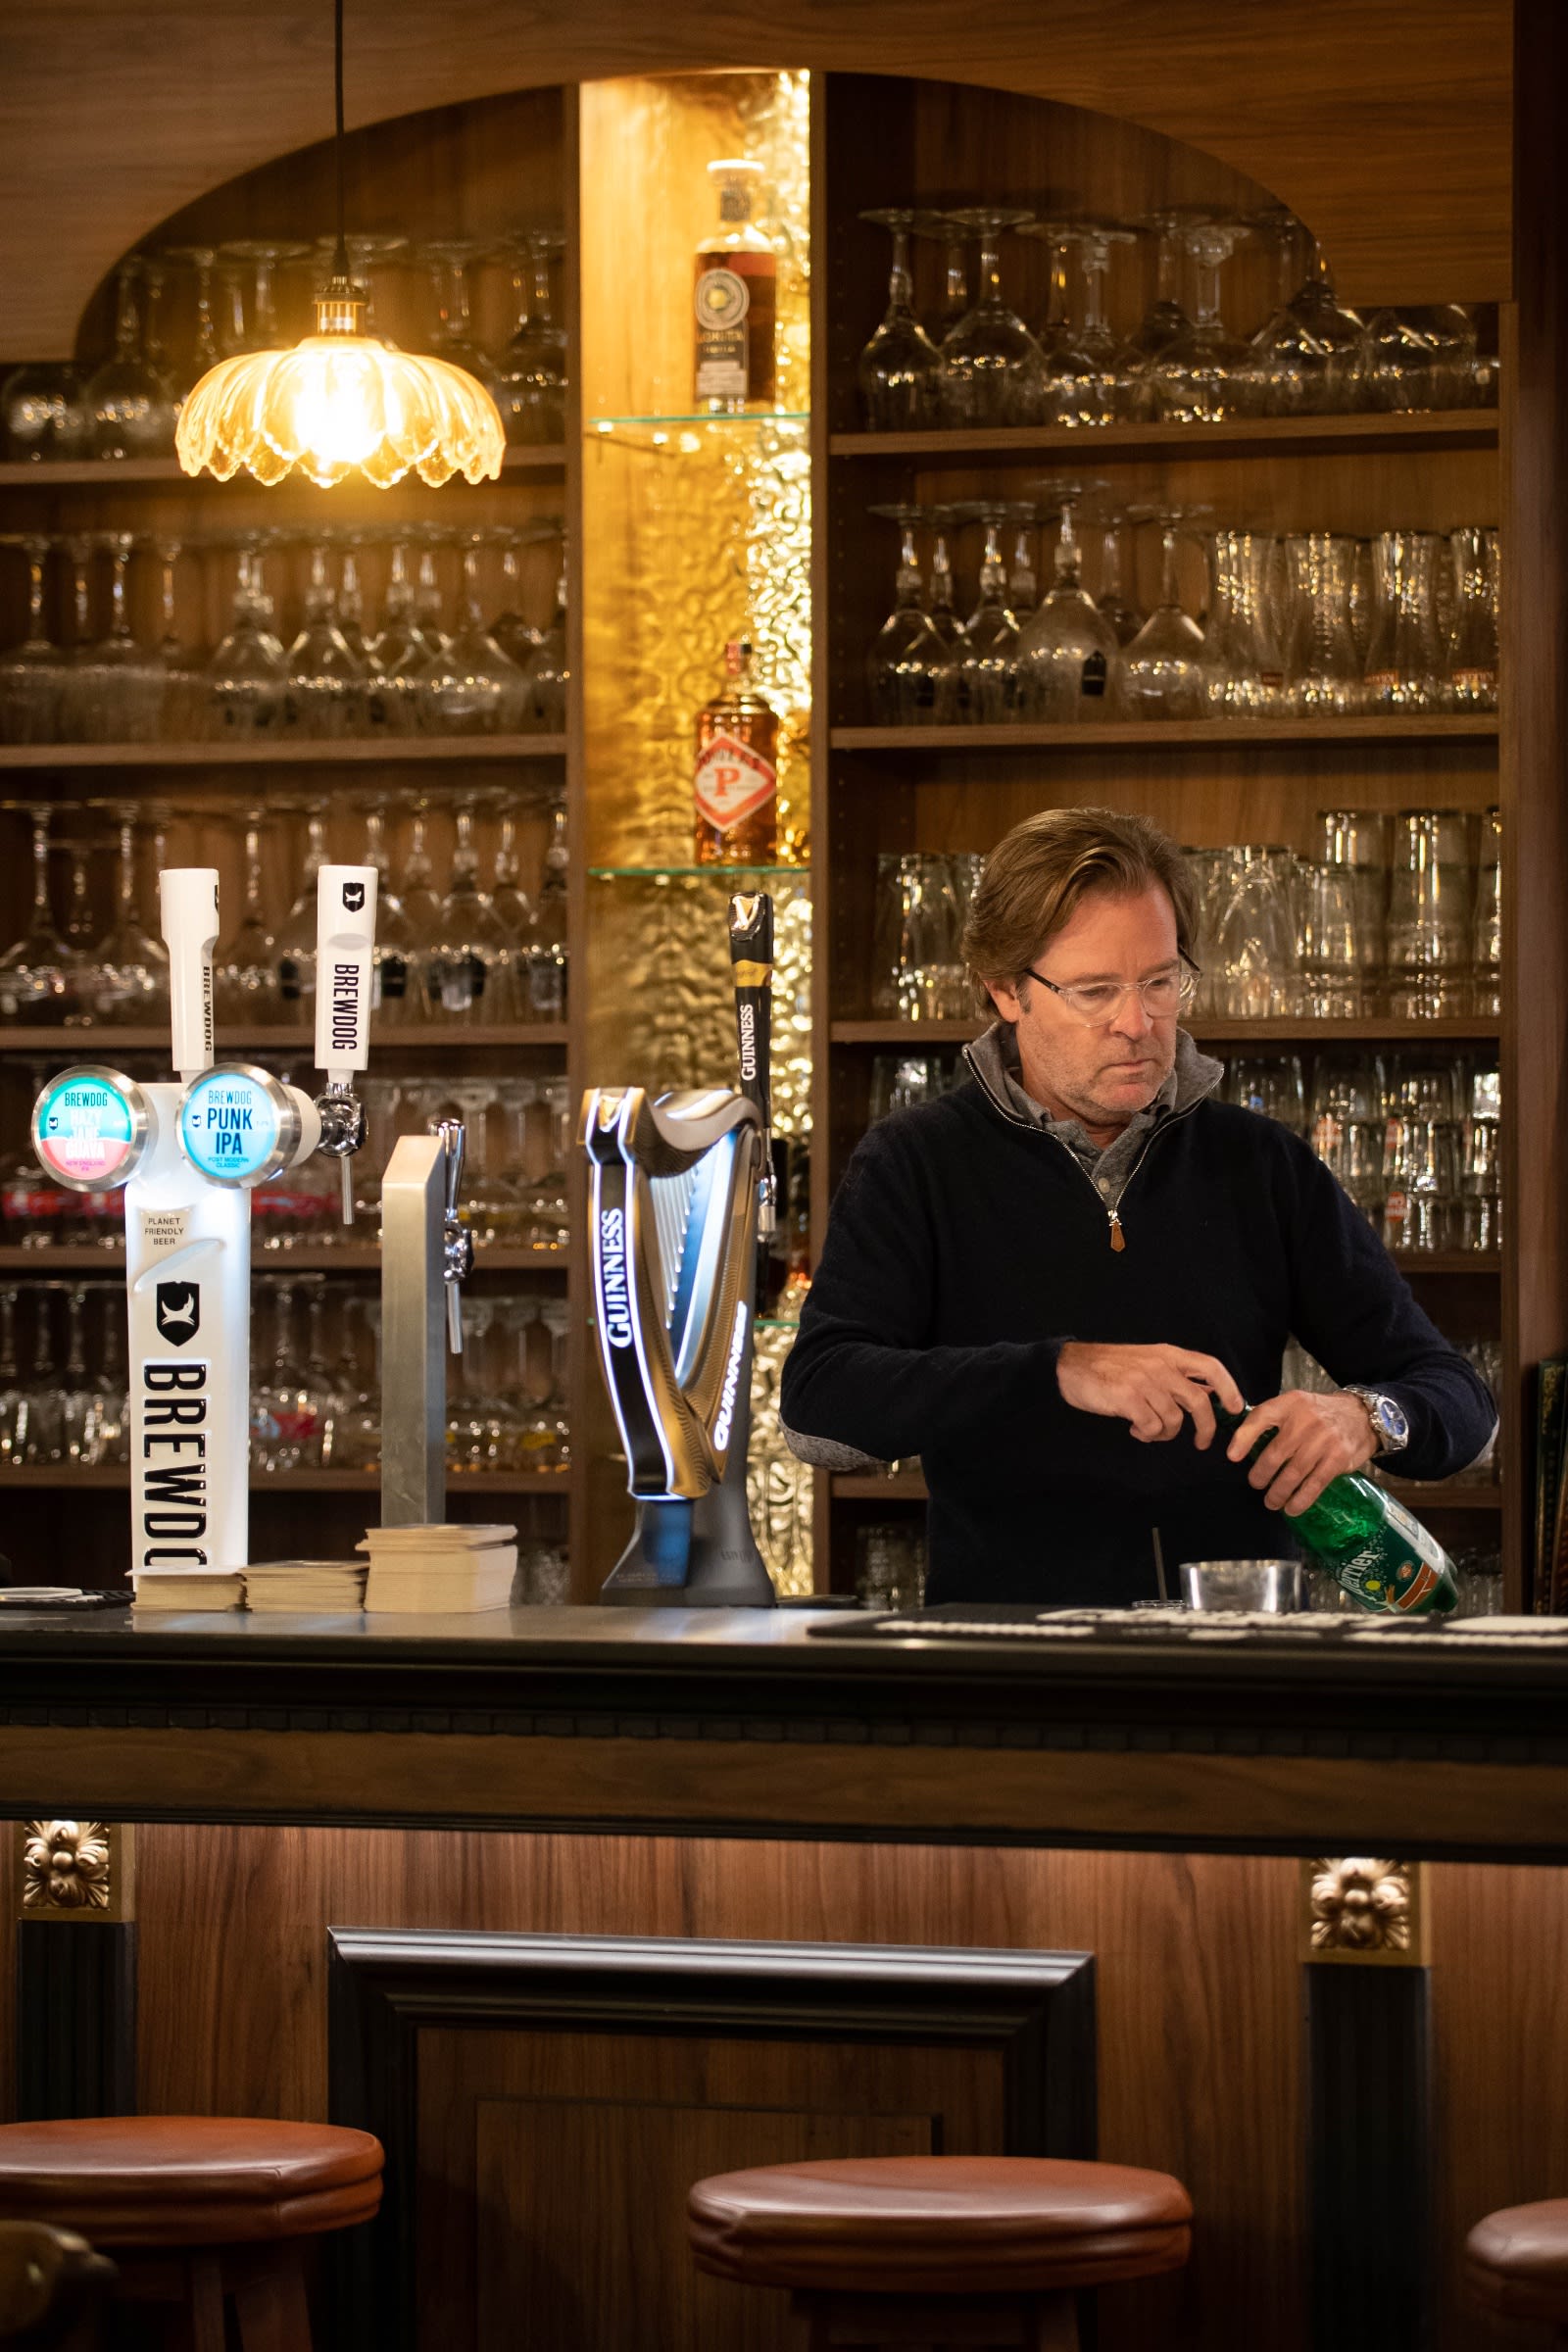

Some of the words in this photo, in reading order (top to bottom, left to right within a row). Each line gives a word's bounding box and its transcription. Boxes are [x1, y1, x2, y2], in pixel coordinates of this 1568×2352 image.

[713, 767, 740, 798] P
[203, 966, 213, 1052] BREWDOG
[332, 963, 360, 1050] BREWDOG
[740, 1004, 757, 1081] GUINNESS
[64, 1092, 108, 1106] BREWDOG
[208, 1090, 252, 1104] BREWDOG
[207, 1107, 253, 1130] PUNK
[216, 1132, 242, 1154] IPA
[144, 1227, 184, 1236] FRIENDLY
[601, 1207, 632, 1348] GUINNESS
